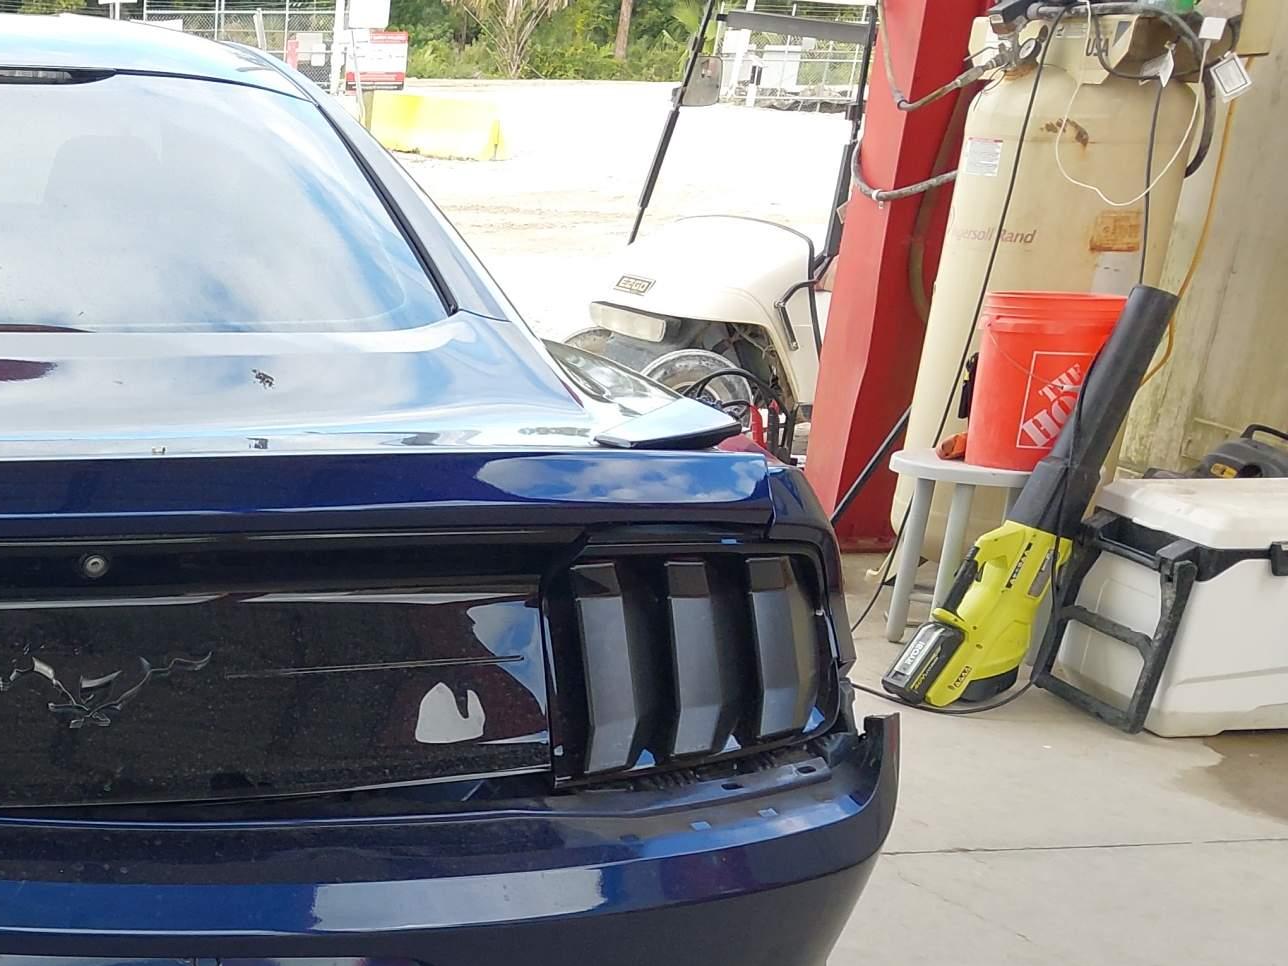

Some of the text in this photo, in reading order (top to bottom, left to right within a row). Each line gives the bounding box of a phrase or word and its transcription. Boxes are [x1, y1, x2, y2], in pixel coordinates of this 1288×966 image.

[1037, 363, 1081, 402] THE
[1022, 395, 1077, 447] HO
[904, 640, 926, 666] RYOBI
